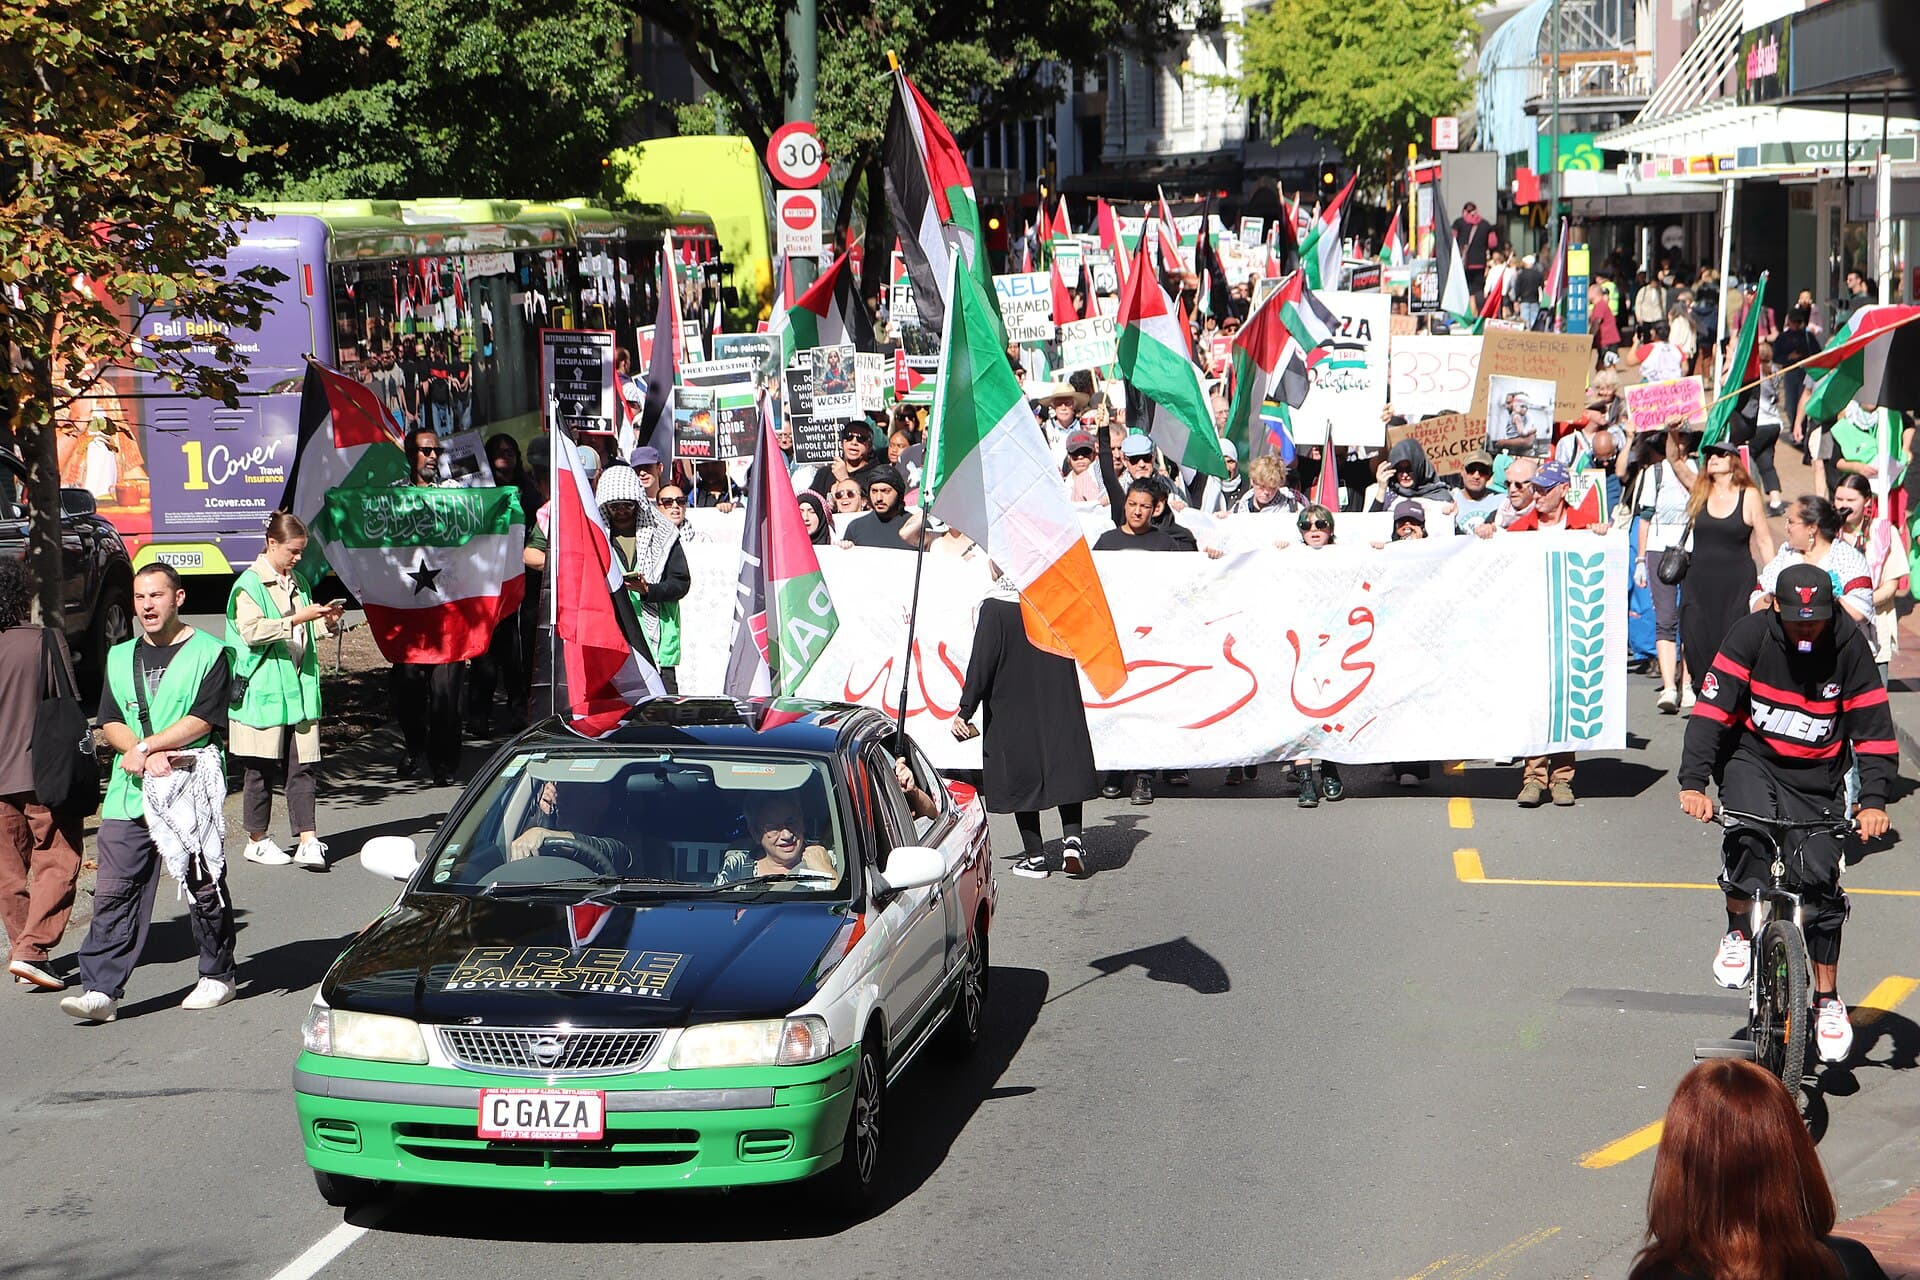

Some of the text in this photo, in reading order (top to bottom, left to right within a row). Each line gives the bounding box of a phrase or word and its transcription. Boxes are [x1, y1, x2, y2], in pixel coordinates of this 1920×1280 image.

[783, 143, 816, 166] 30
[786, 234, 813, 243] Except
[996, 276, 1049, 298] AEL
[893, 286, 914, 303] FR
[1000, 299, 1050, 314] SHAMED
[1007, 315, 1024, 327] OF
[153, 321, 182, 336] Bali
[1008, 325, 1046, 340] OTHING
[1341, 316, 1372, 341] ZA
[235, 343, 261, 353] Need.
[579, 346, 593, 355] THE
[1496, 337, 1569, 354] CEASEFIRE
[556, 358, 601, 366] OCCUPATION
[856, 354, 881, 369] BING
[682, 366, 704, 375] FREE
[705, 362, 750, 372] PALESTINE
[570, 382, 588, 390] FREE
[860, 384, 873, 395] OT
[559, 393, 597, 402] PALESTINE
[817, 395, 853, 406] WCNSF
[719, 420, 746, 434] OCIDE
[806, 433, 826, 441] WHEN
[679, 445, 711, 456] NOW.
[721, 445, 739, 458] AZA
[797, 442, 821, 450] MIDDLE
[181, 440, 282, 490] 1Cover
[259, 465, 284, 475] Travel
[245, 475, 284, 484] Insurance
[204, 498, 266, 508] 1Cover.co.nz
[1750, 697, 1836, 743] HIEF
[458, 946, 683, 974] FREE
[450, 967, 670, 990] PALESTINE
[445, 981, 662, 997] BOYCOTT ISRAEL
